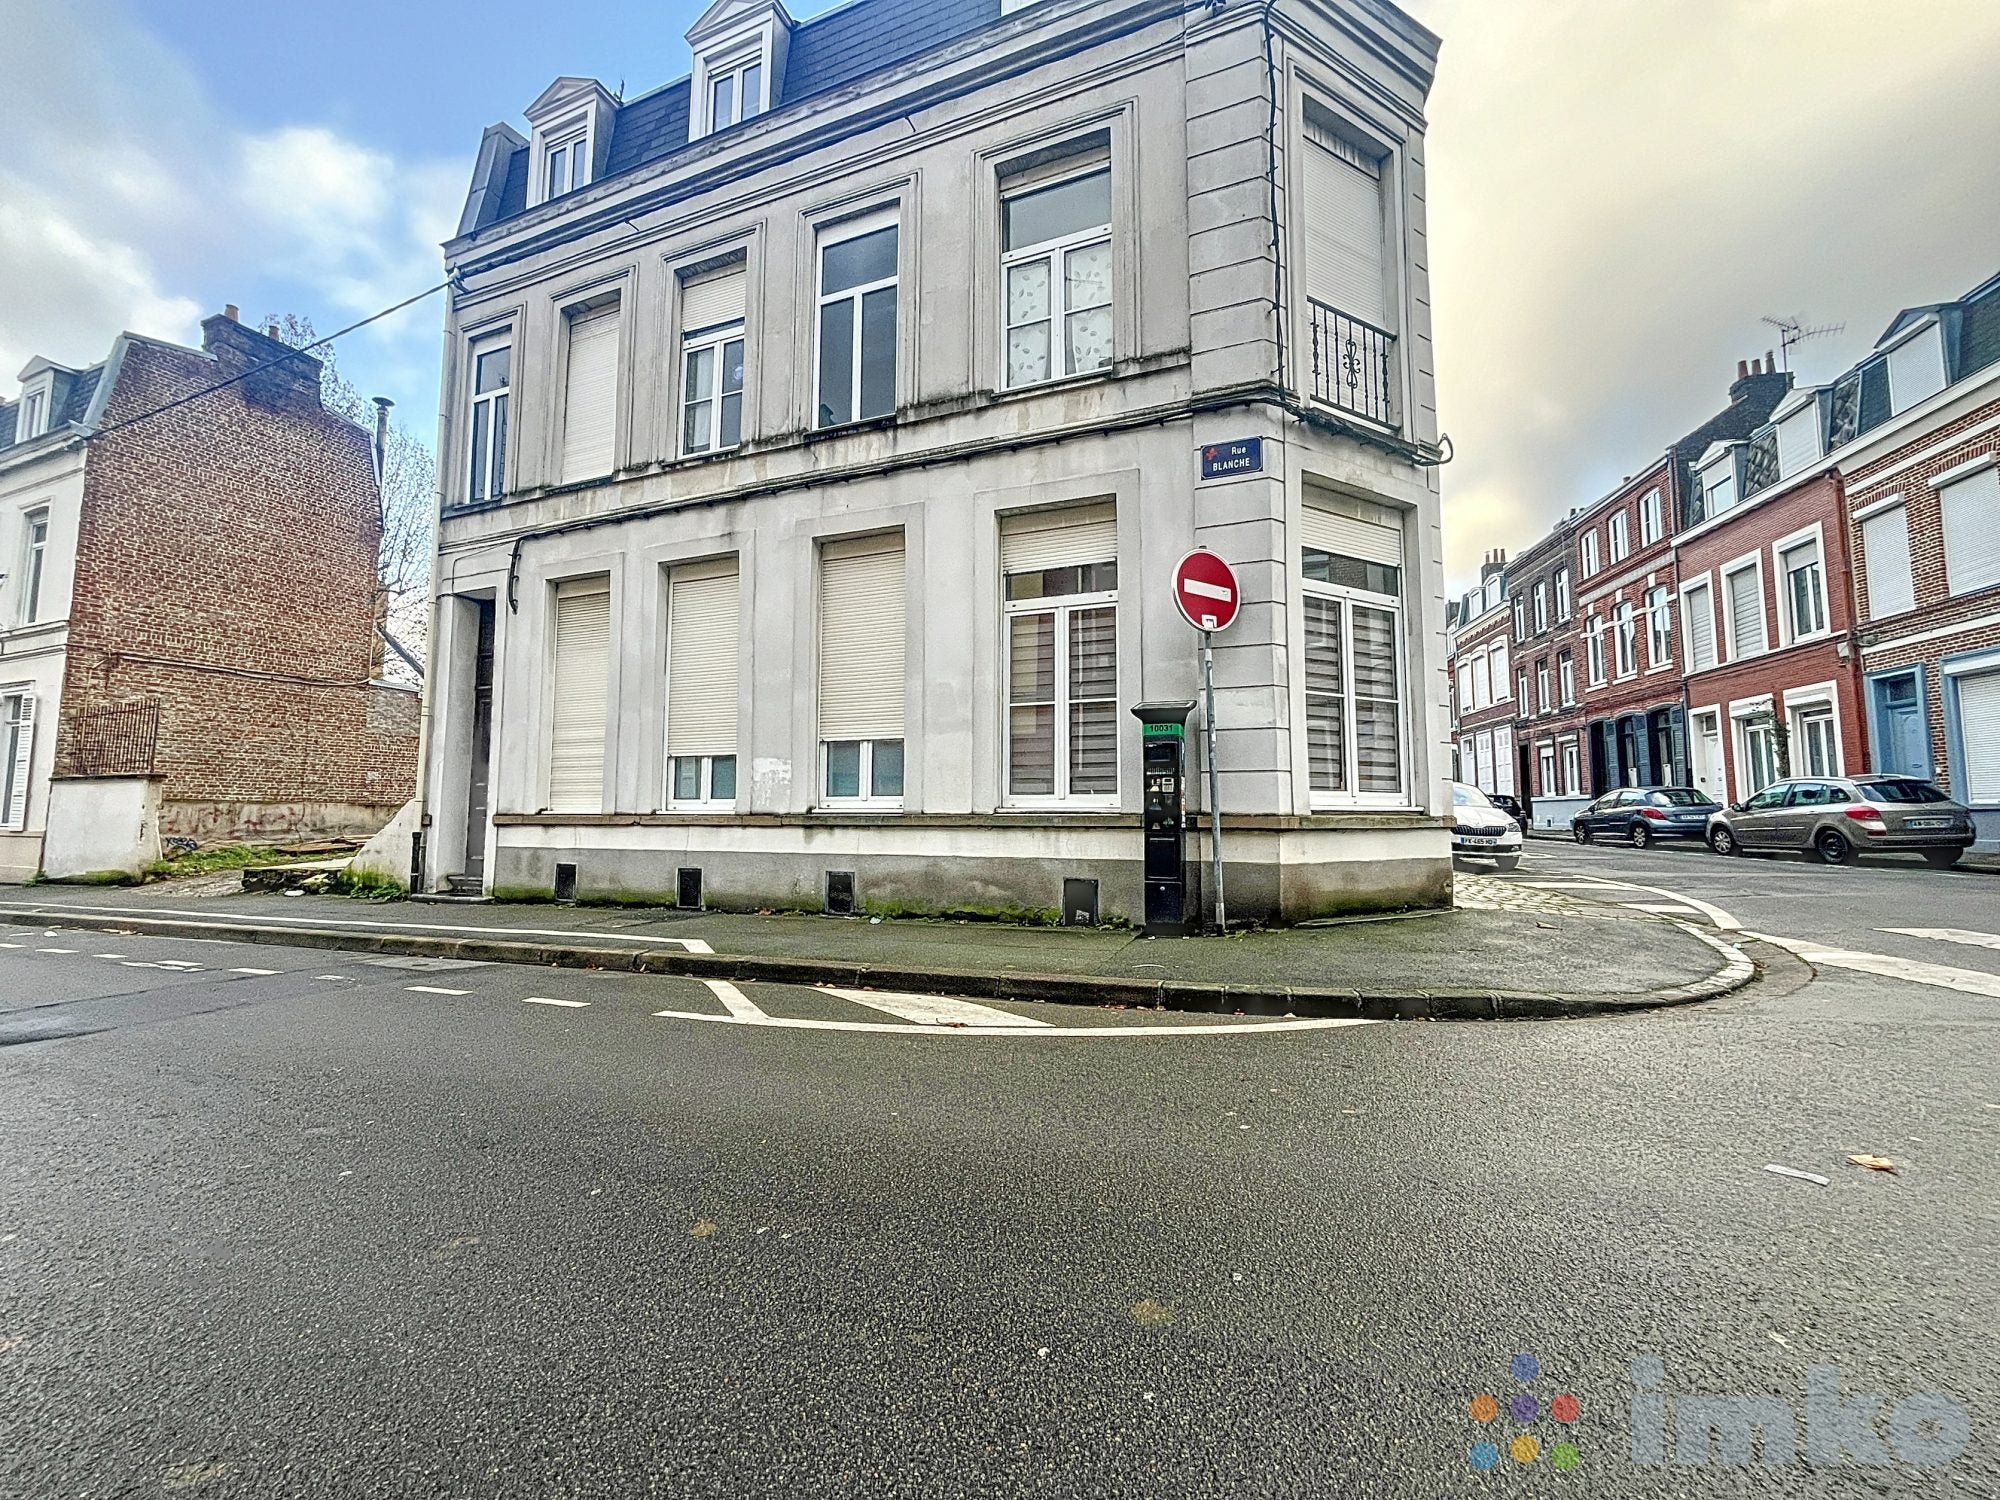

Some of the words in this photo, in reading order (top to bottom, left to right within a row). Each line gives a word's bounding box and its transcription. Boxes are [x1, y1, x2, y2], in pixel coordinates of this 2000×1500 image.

[1231, 446, 1247, 455] Rue
[1212, 457, 1250, 472] BLANCHE
[1150, 724, 1173, 732] 10031
